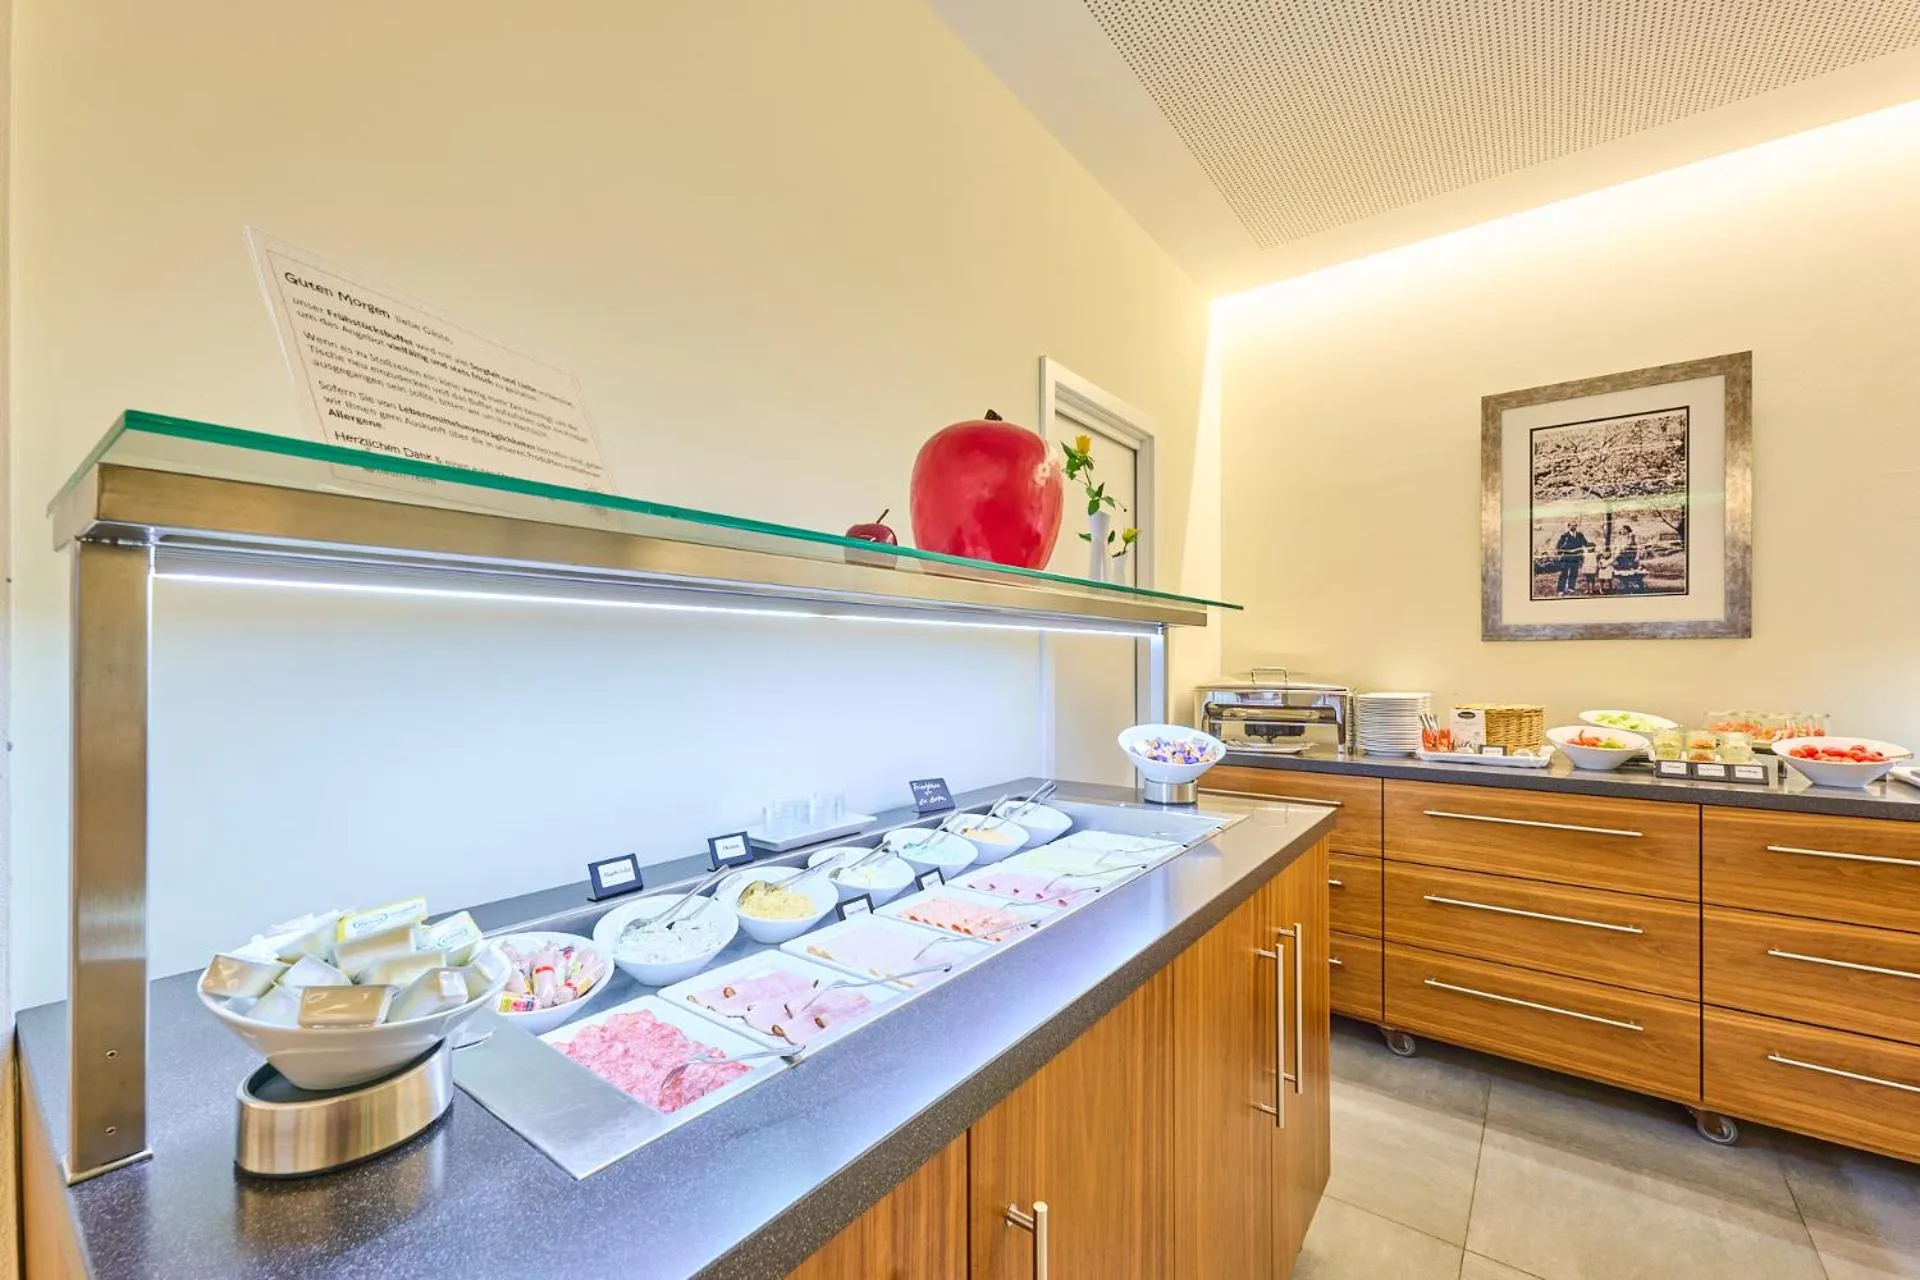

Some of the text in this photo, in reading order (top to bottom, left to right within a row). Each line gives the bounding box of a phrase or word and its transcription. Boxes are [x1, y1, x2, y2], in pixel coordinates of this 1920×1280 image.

[284, 271, 334, 296] Guten
[338, 291, 390, 318] Morgen
[292, 296, 324, 313] unser
[326, 308, 413, 345] Frühstücksbuffet
[296, 310, 317, 321] um
[341, 325, 385, 347] Angebot
[386, 341, 429, 362] vielfältig
[430, 357, 448, 368] und
[303, 331, 337, 347] Wenn
[309, 345, 345, 362] Tische
[318, 380, 357, 397] Sofern
[358, 392, 374, 402] Sie
[345, 401, 376, 414] Ihnen
[404, 417, 447, 434] Auskunft
[334, 431, 401, 454] Herzlichen
[403, 448, 433, 461] Dank
